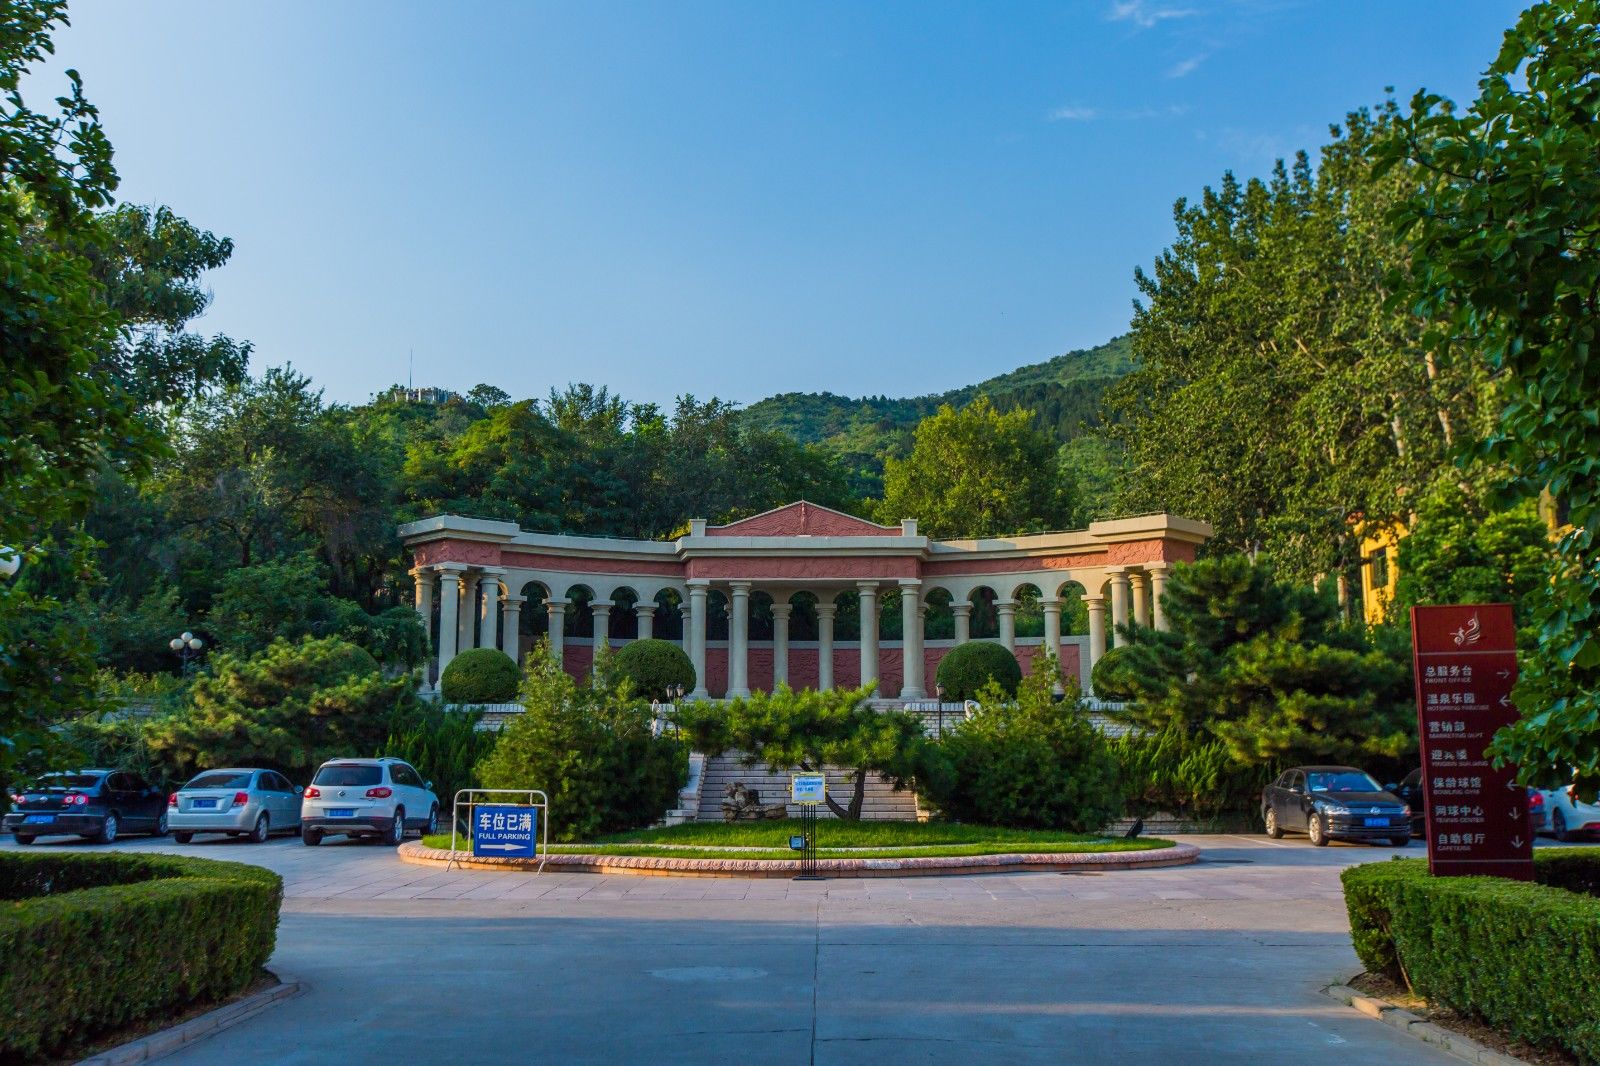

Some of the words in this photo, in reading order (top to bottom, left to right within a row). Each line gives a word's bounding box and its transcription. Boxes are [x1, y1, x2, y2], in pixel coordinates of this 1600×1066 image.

[1425, 666, 1472, 676] 总服务台
[1428, 693, 1475, 704] 温泉乐园
[1429, 722, 1465, 732] 营销部
[1434, 777, 1482, 788] 保龄球馆
[1436, 805, 1483, 816] 网球中心
[479, 812, 532, 832] 车位已满
[1438, 834, 1485, 844] 自助餐厅
